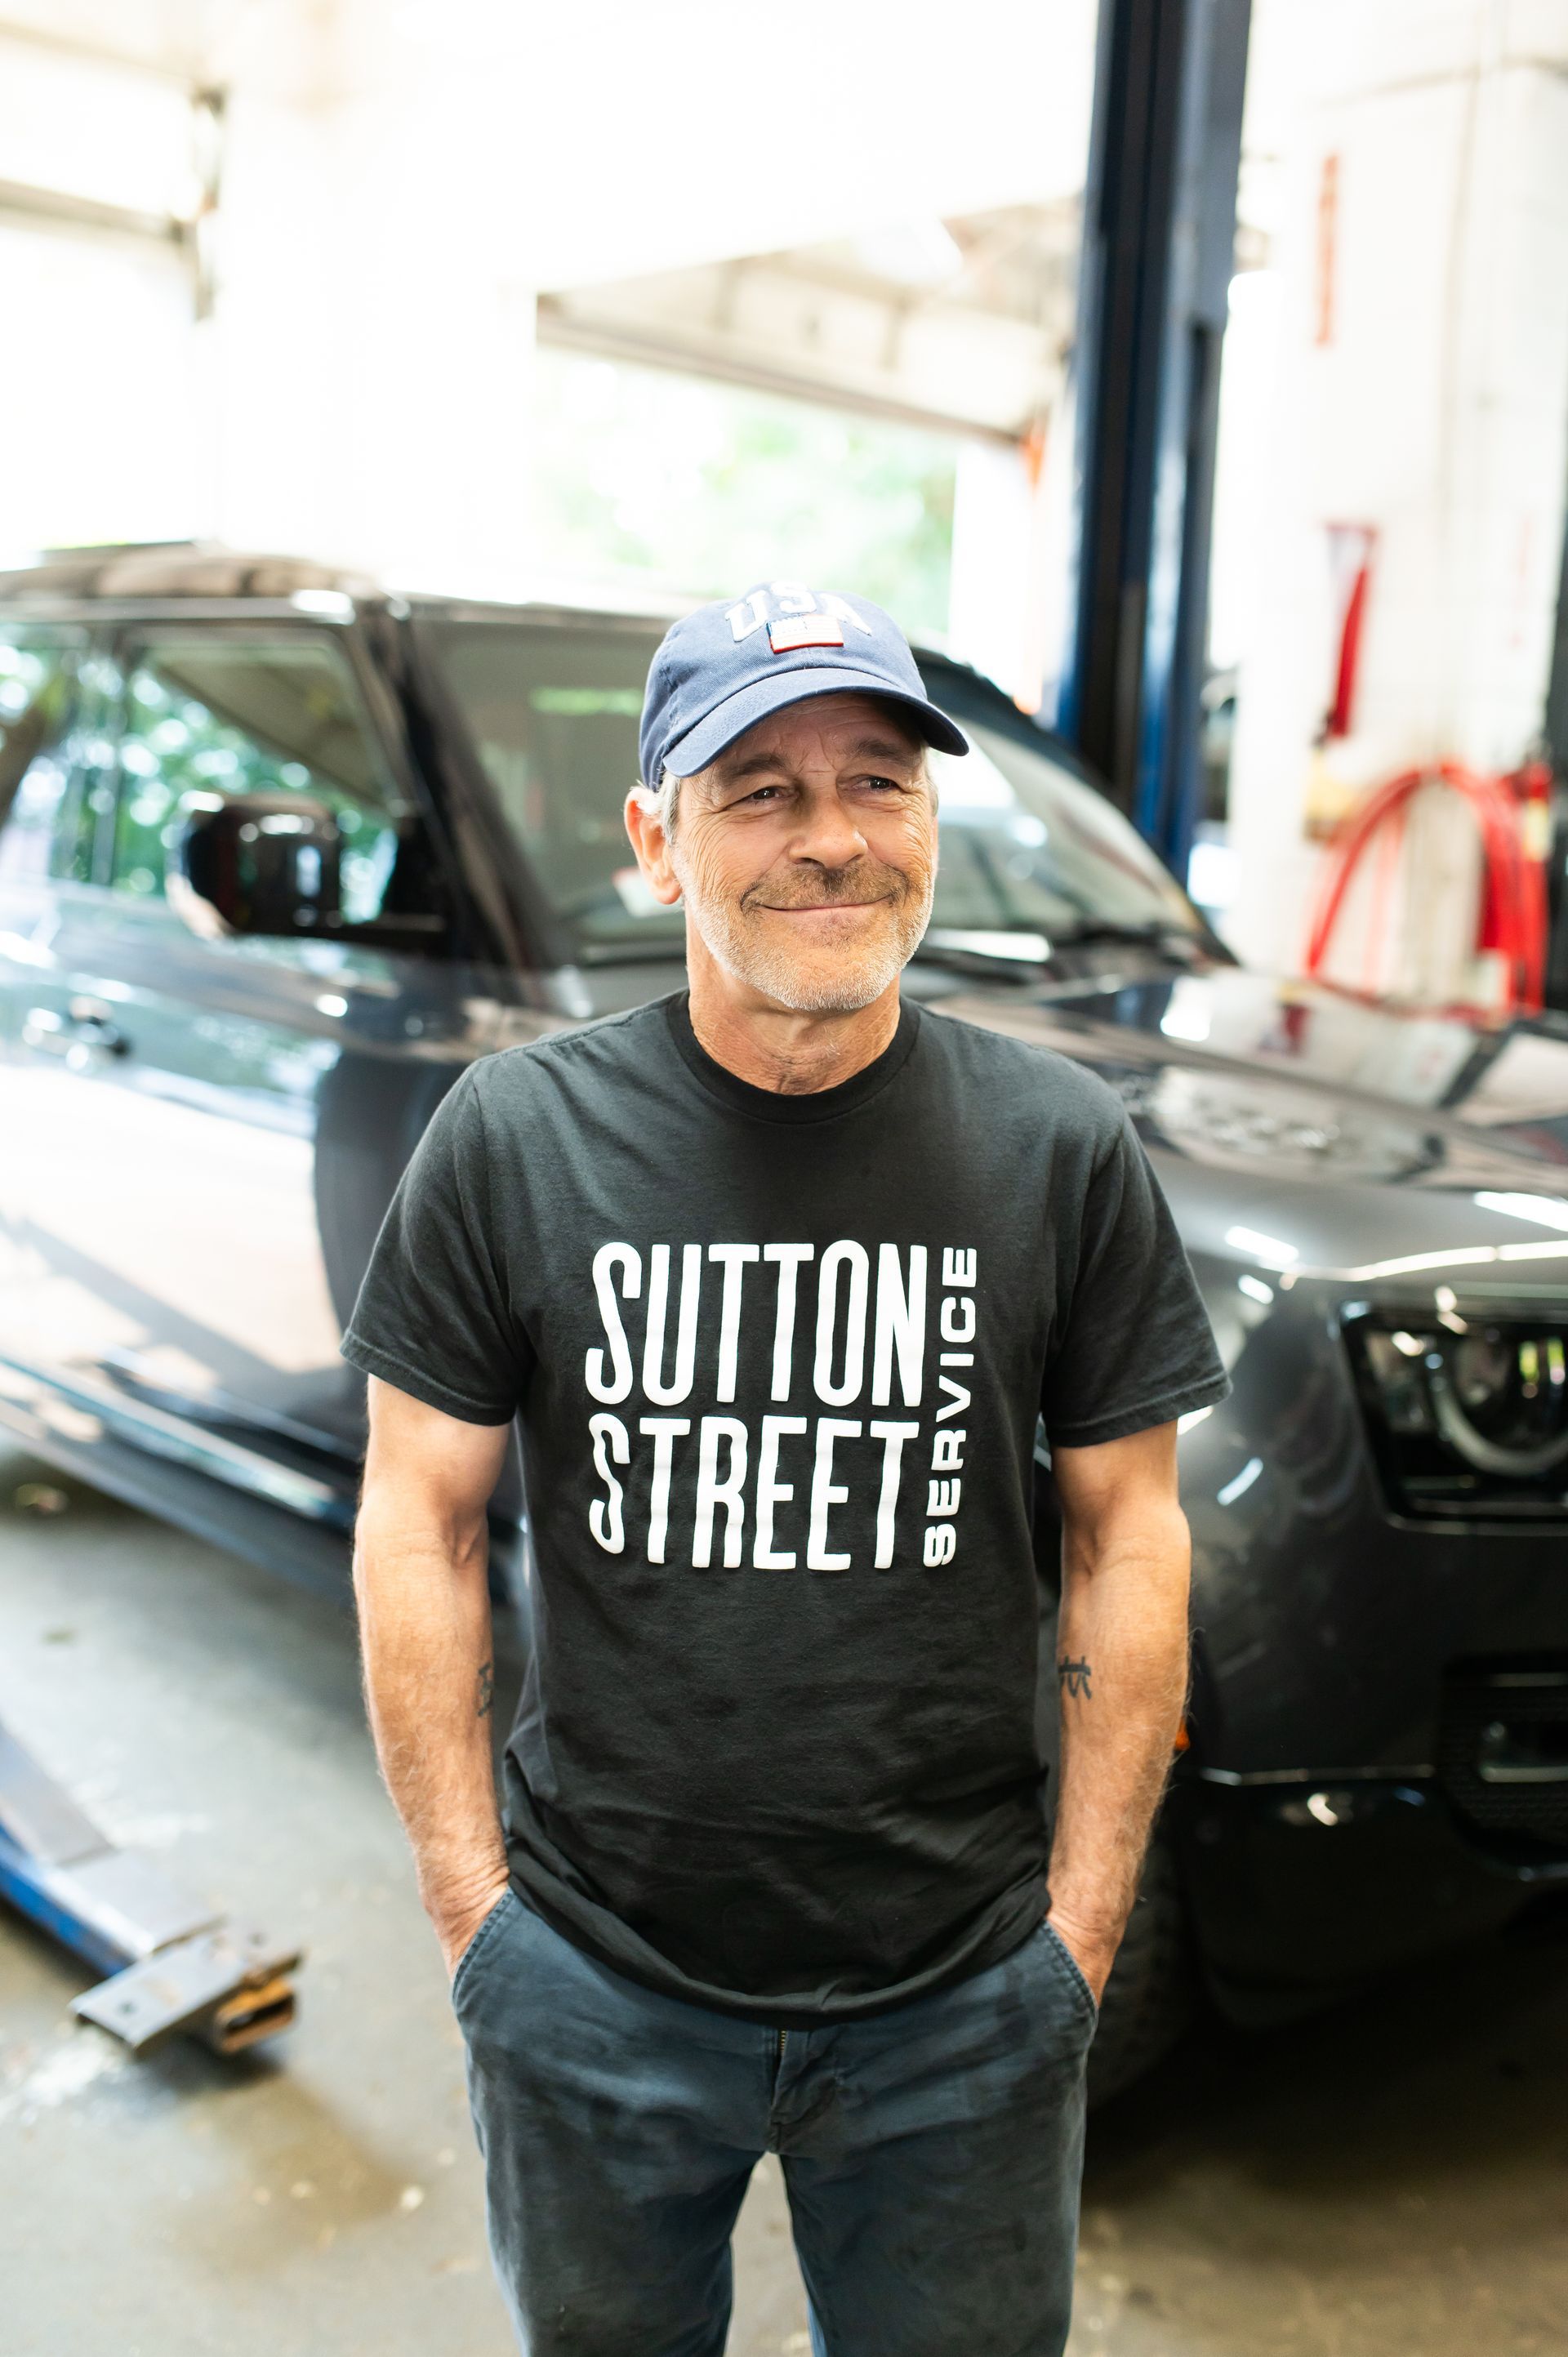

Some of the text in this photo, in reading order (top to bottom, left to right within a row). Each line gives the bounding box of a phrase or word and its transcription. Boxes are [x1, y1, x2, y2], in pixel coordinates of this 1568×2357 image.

[585, 1239, 928, 1407] SUTTON
[923, 1247, 978, 1567] SERVICE
[588, 1412, 920, 1571] STREET
